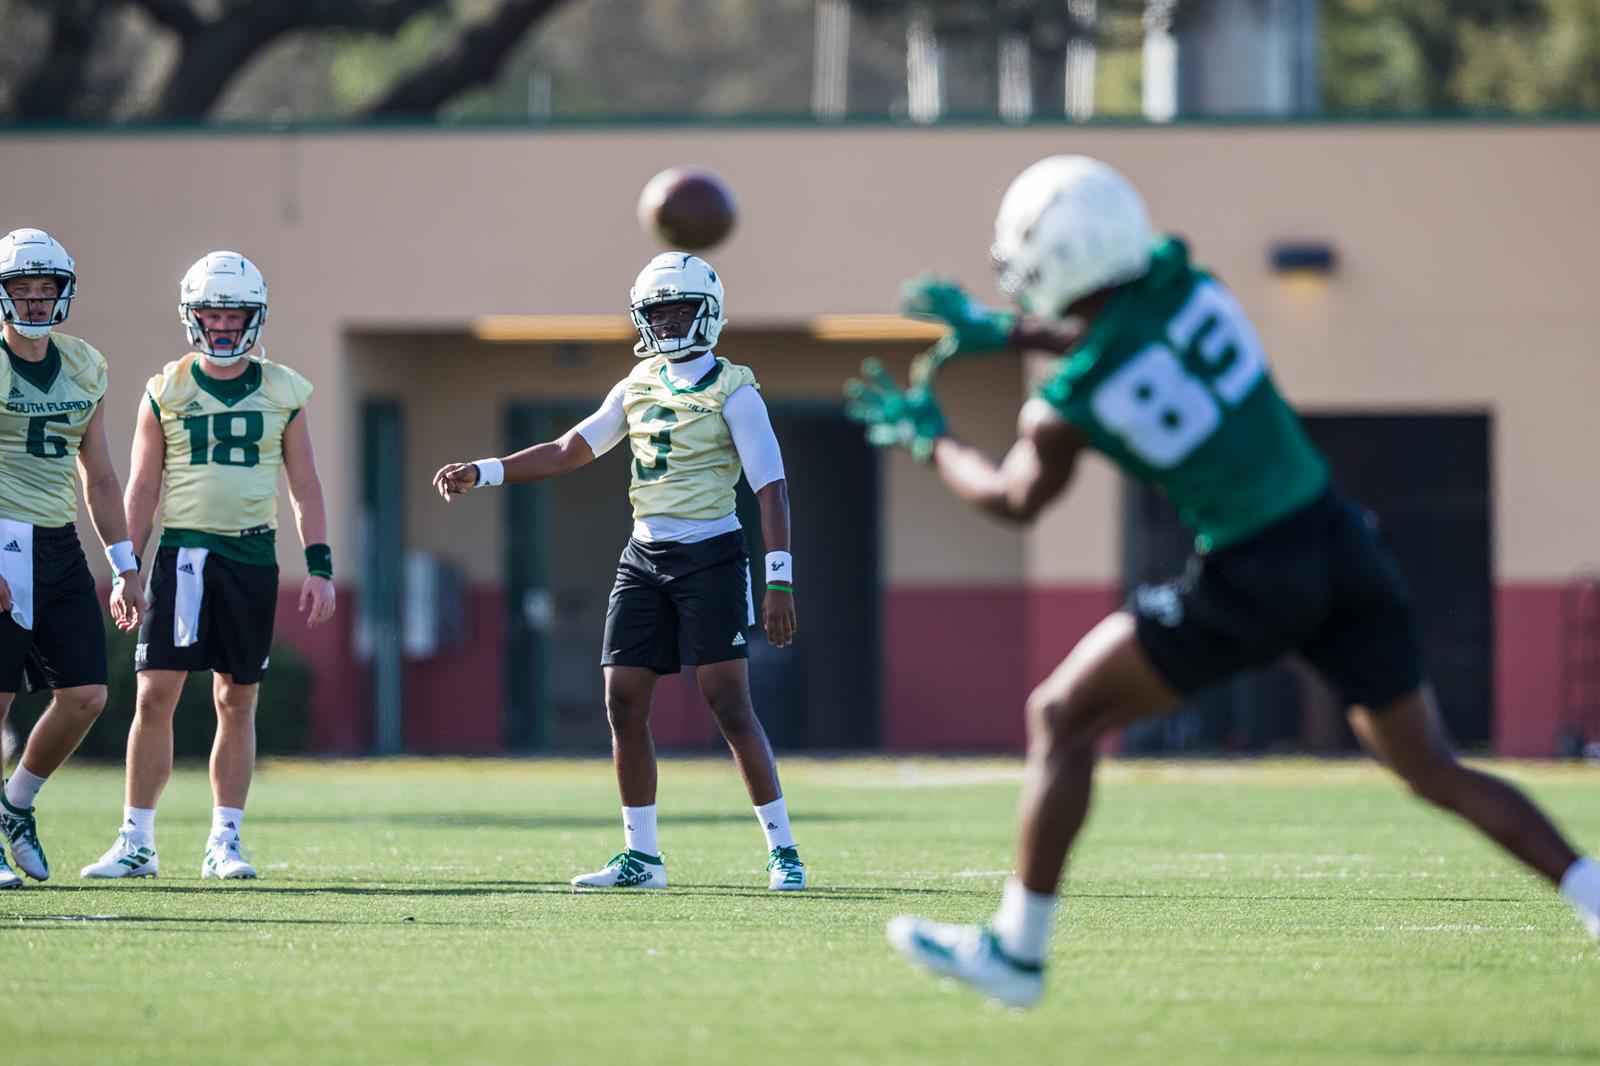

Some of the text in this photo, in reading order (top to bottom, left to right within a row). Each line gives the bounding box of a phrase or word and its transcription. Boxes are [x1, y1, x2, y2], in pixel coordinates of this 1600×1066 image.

[1091, 280, 1267, 469] 83
[6, 400, 95, 413] SOUTH FLORIDA
[26, 413, 71, 458] 6
[183, 411, 264, 468] 18
[636, 404, 679, 481] 3
[614, 871, 653, 888] adidas
